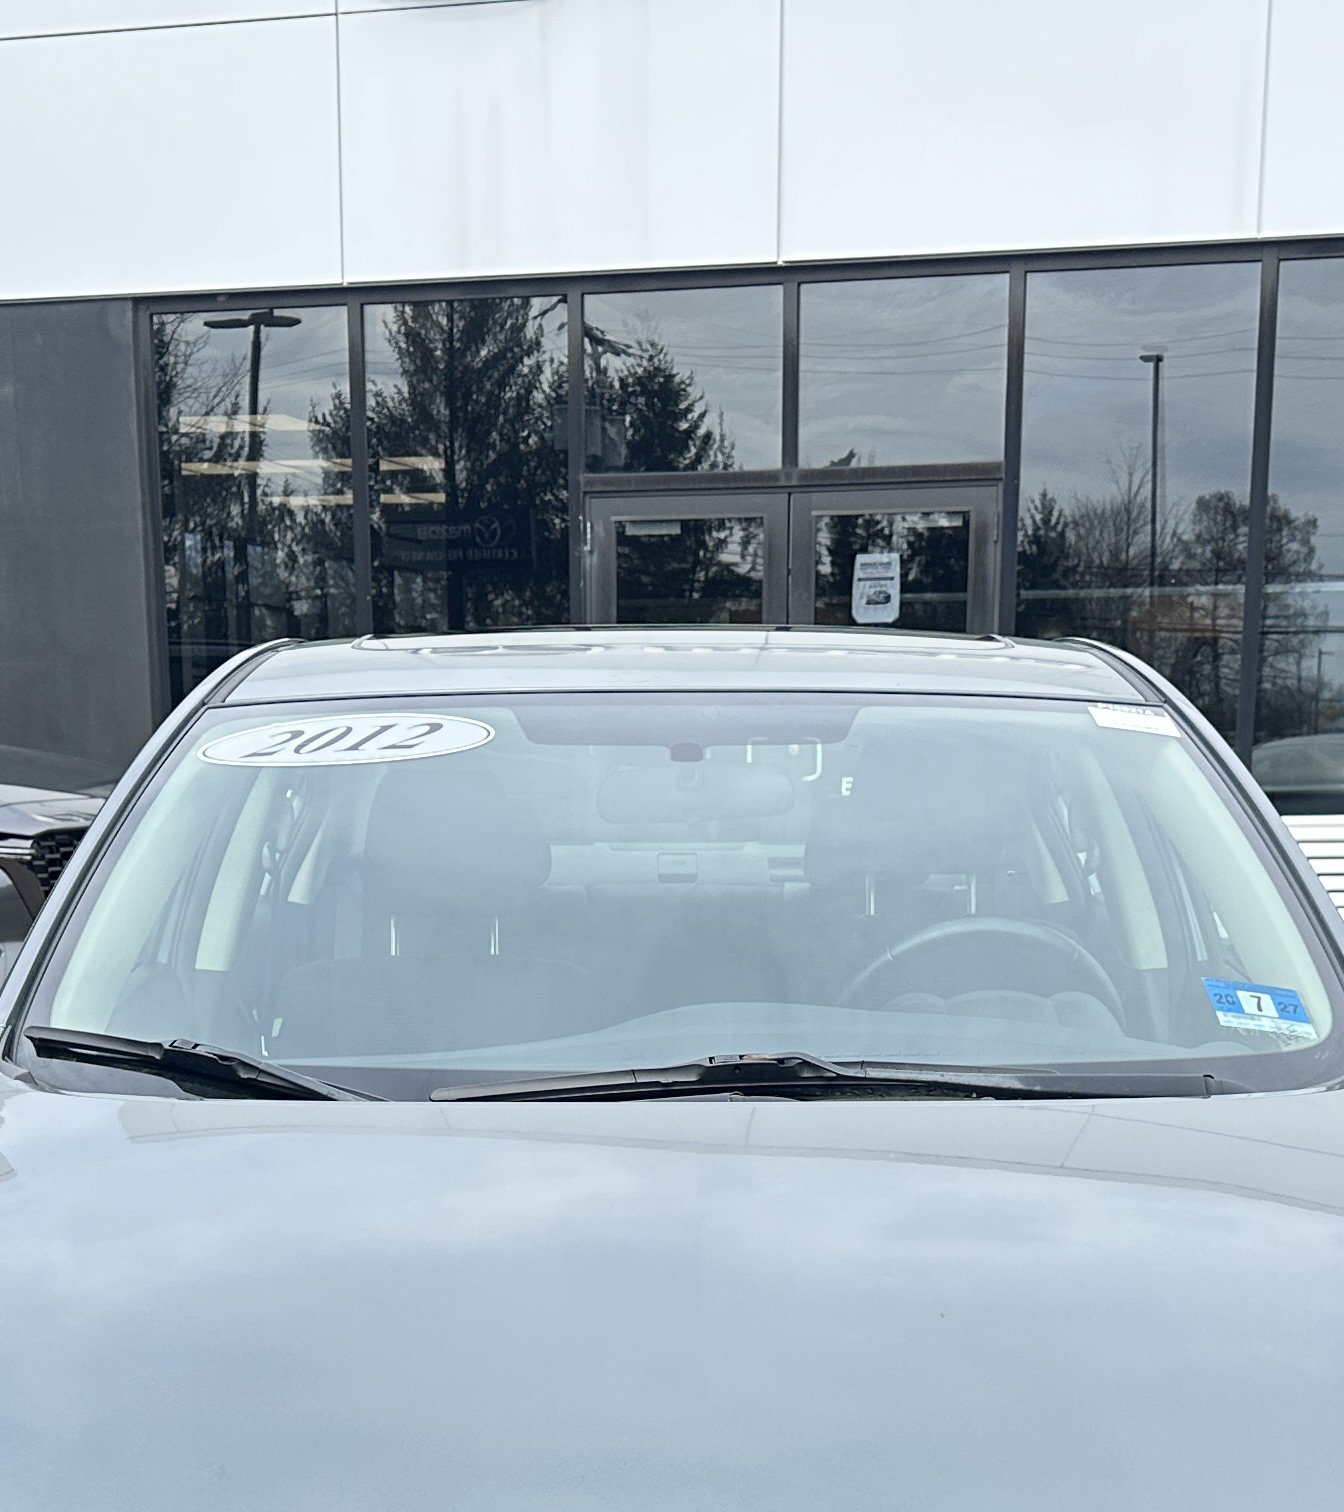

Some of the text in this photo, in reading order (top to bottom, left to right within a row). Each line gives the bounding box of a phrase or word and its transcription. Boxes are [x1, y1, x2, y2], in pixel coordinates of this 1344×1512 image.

[239, 722, 444, 758] 2012
[1249, 994, 1263, 1012] 7
[1277, 1001, 1299, 1014] 27
